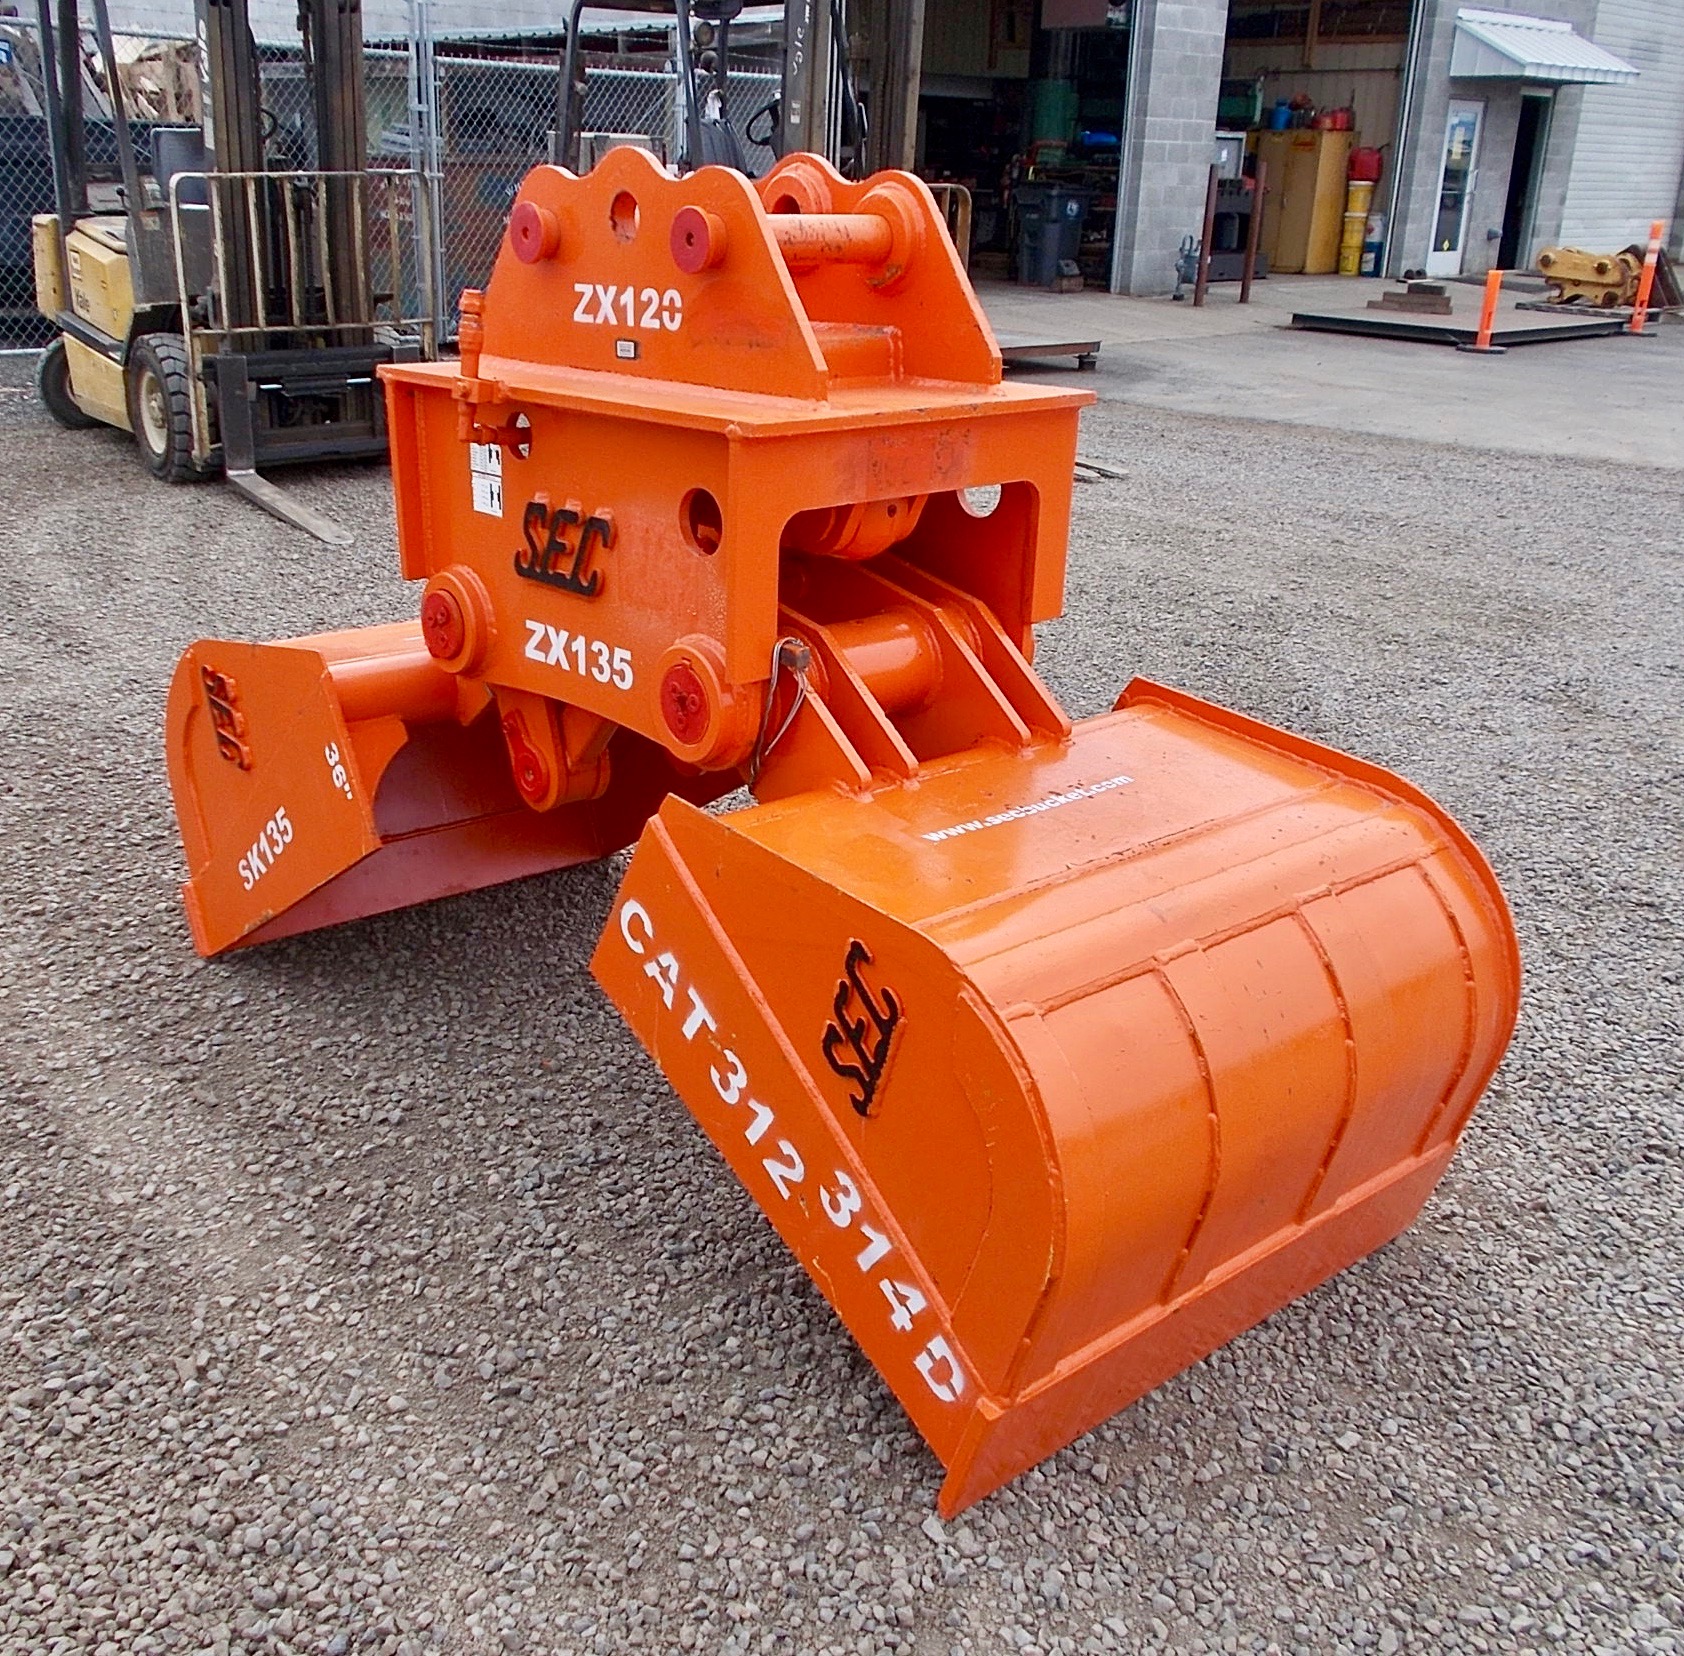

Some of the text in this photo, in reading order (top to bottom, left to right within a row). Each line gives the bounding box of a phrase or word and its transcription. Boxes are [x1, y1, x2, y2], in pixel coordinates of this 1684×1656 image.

[573, 282, 683, 332] ZX120
[514, 500, 613, 598] SEC
[524, 619, 634, 691] ZX135
[237, 806, 293, 891] SK135
[921, 773, 1135, 843] www.secbucket.com
[822, 938, 902, 1120] SEC
[618, 897, 967, 1404] CAT 312 314D
